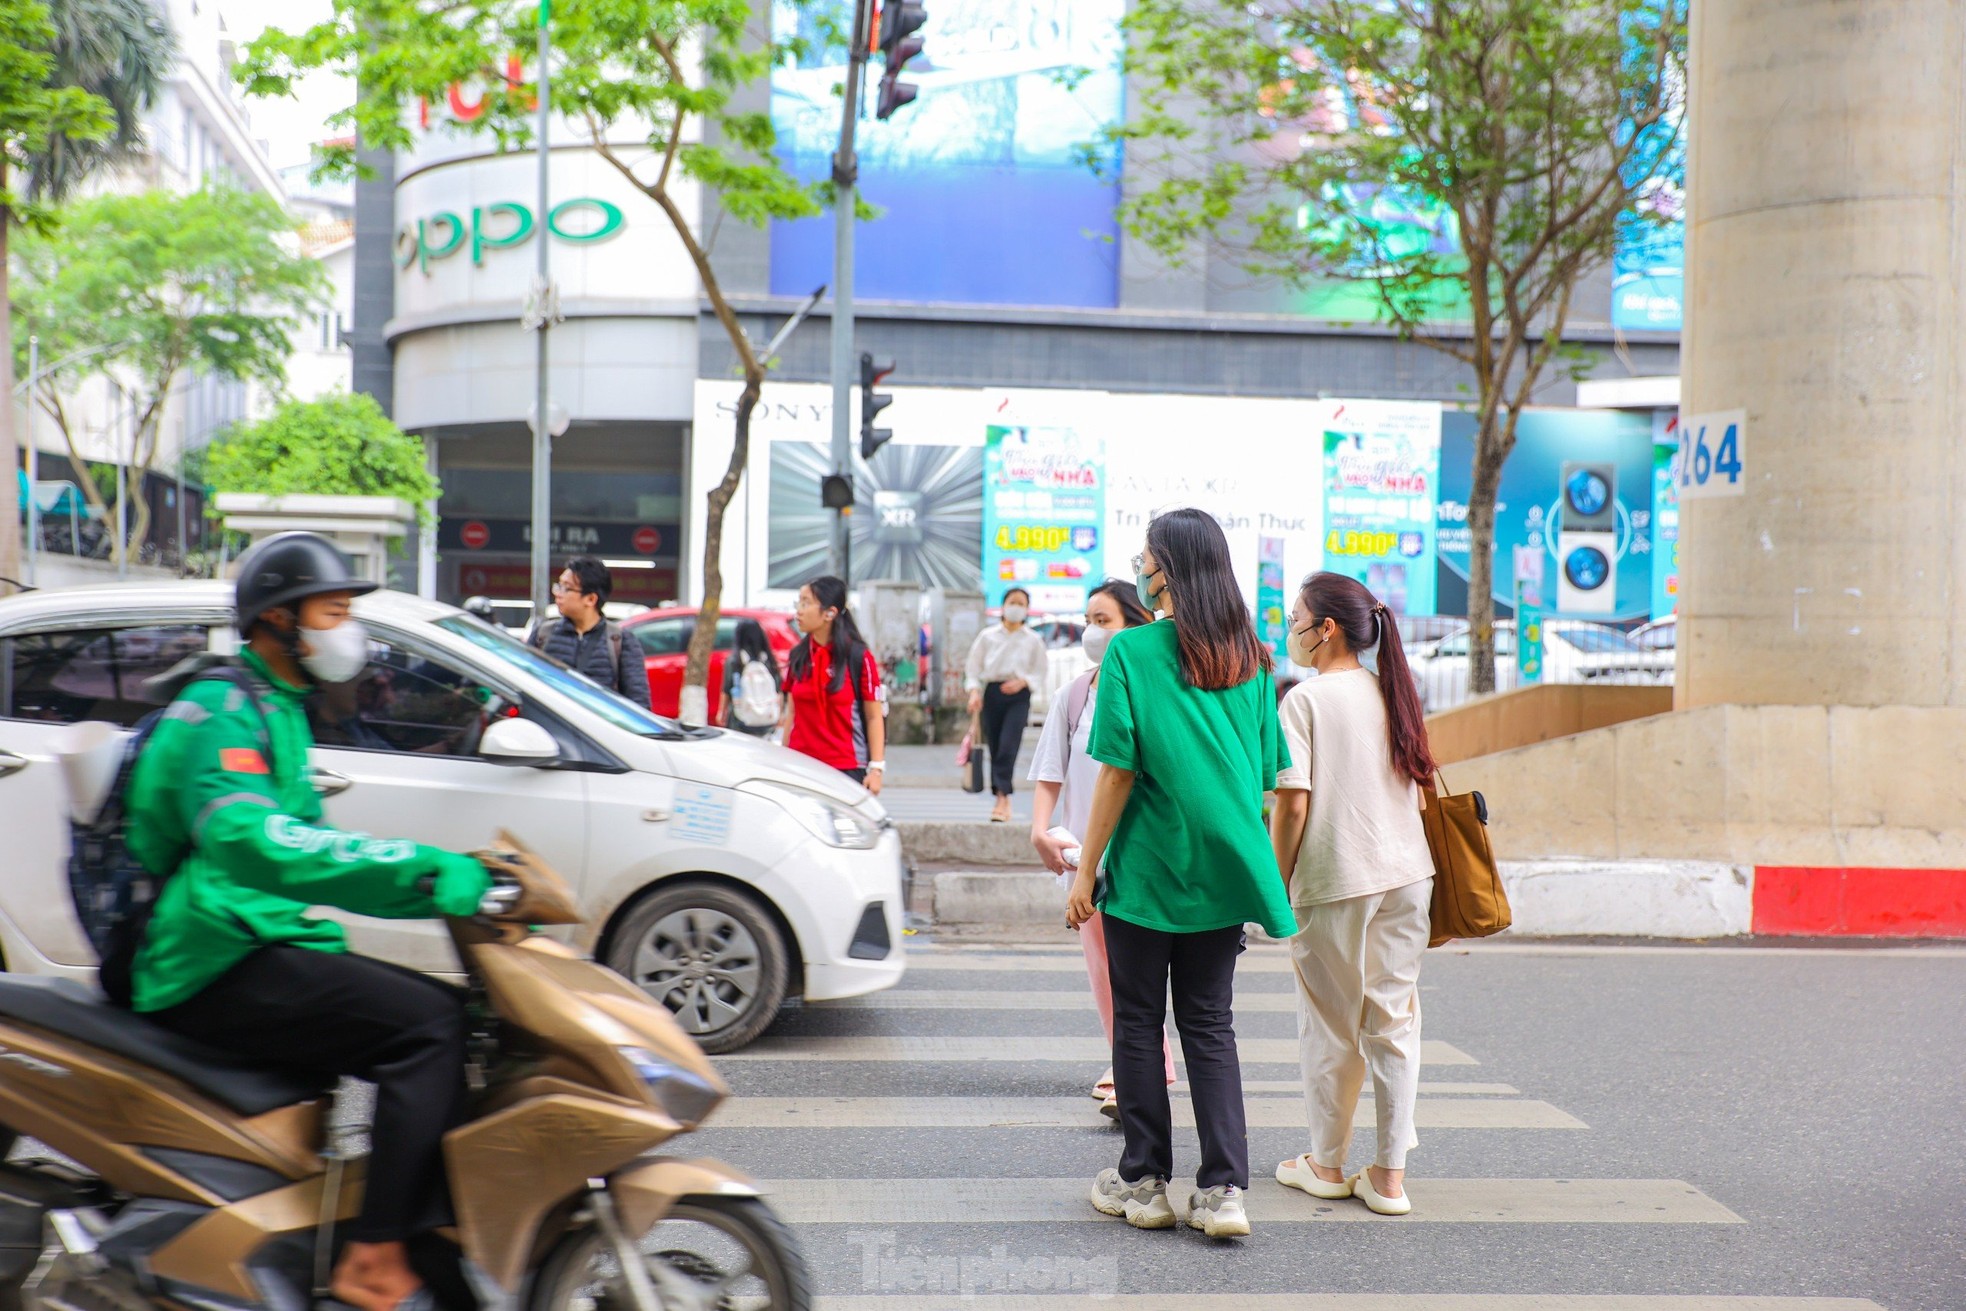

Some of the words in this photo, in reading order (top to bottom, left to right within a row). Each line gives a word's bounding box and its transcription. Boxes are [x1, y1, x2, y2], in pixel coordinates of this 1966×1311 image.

[716, 401, 832, 421] SONY
[1682, 424, 1741, 487] 264
[881, 508, 917, 527] XR
